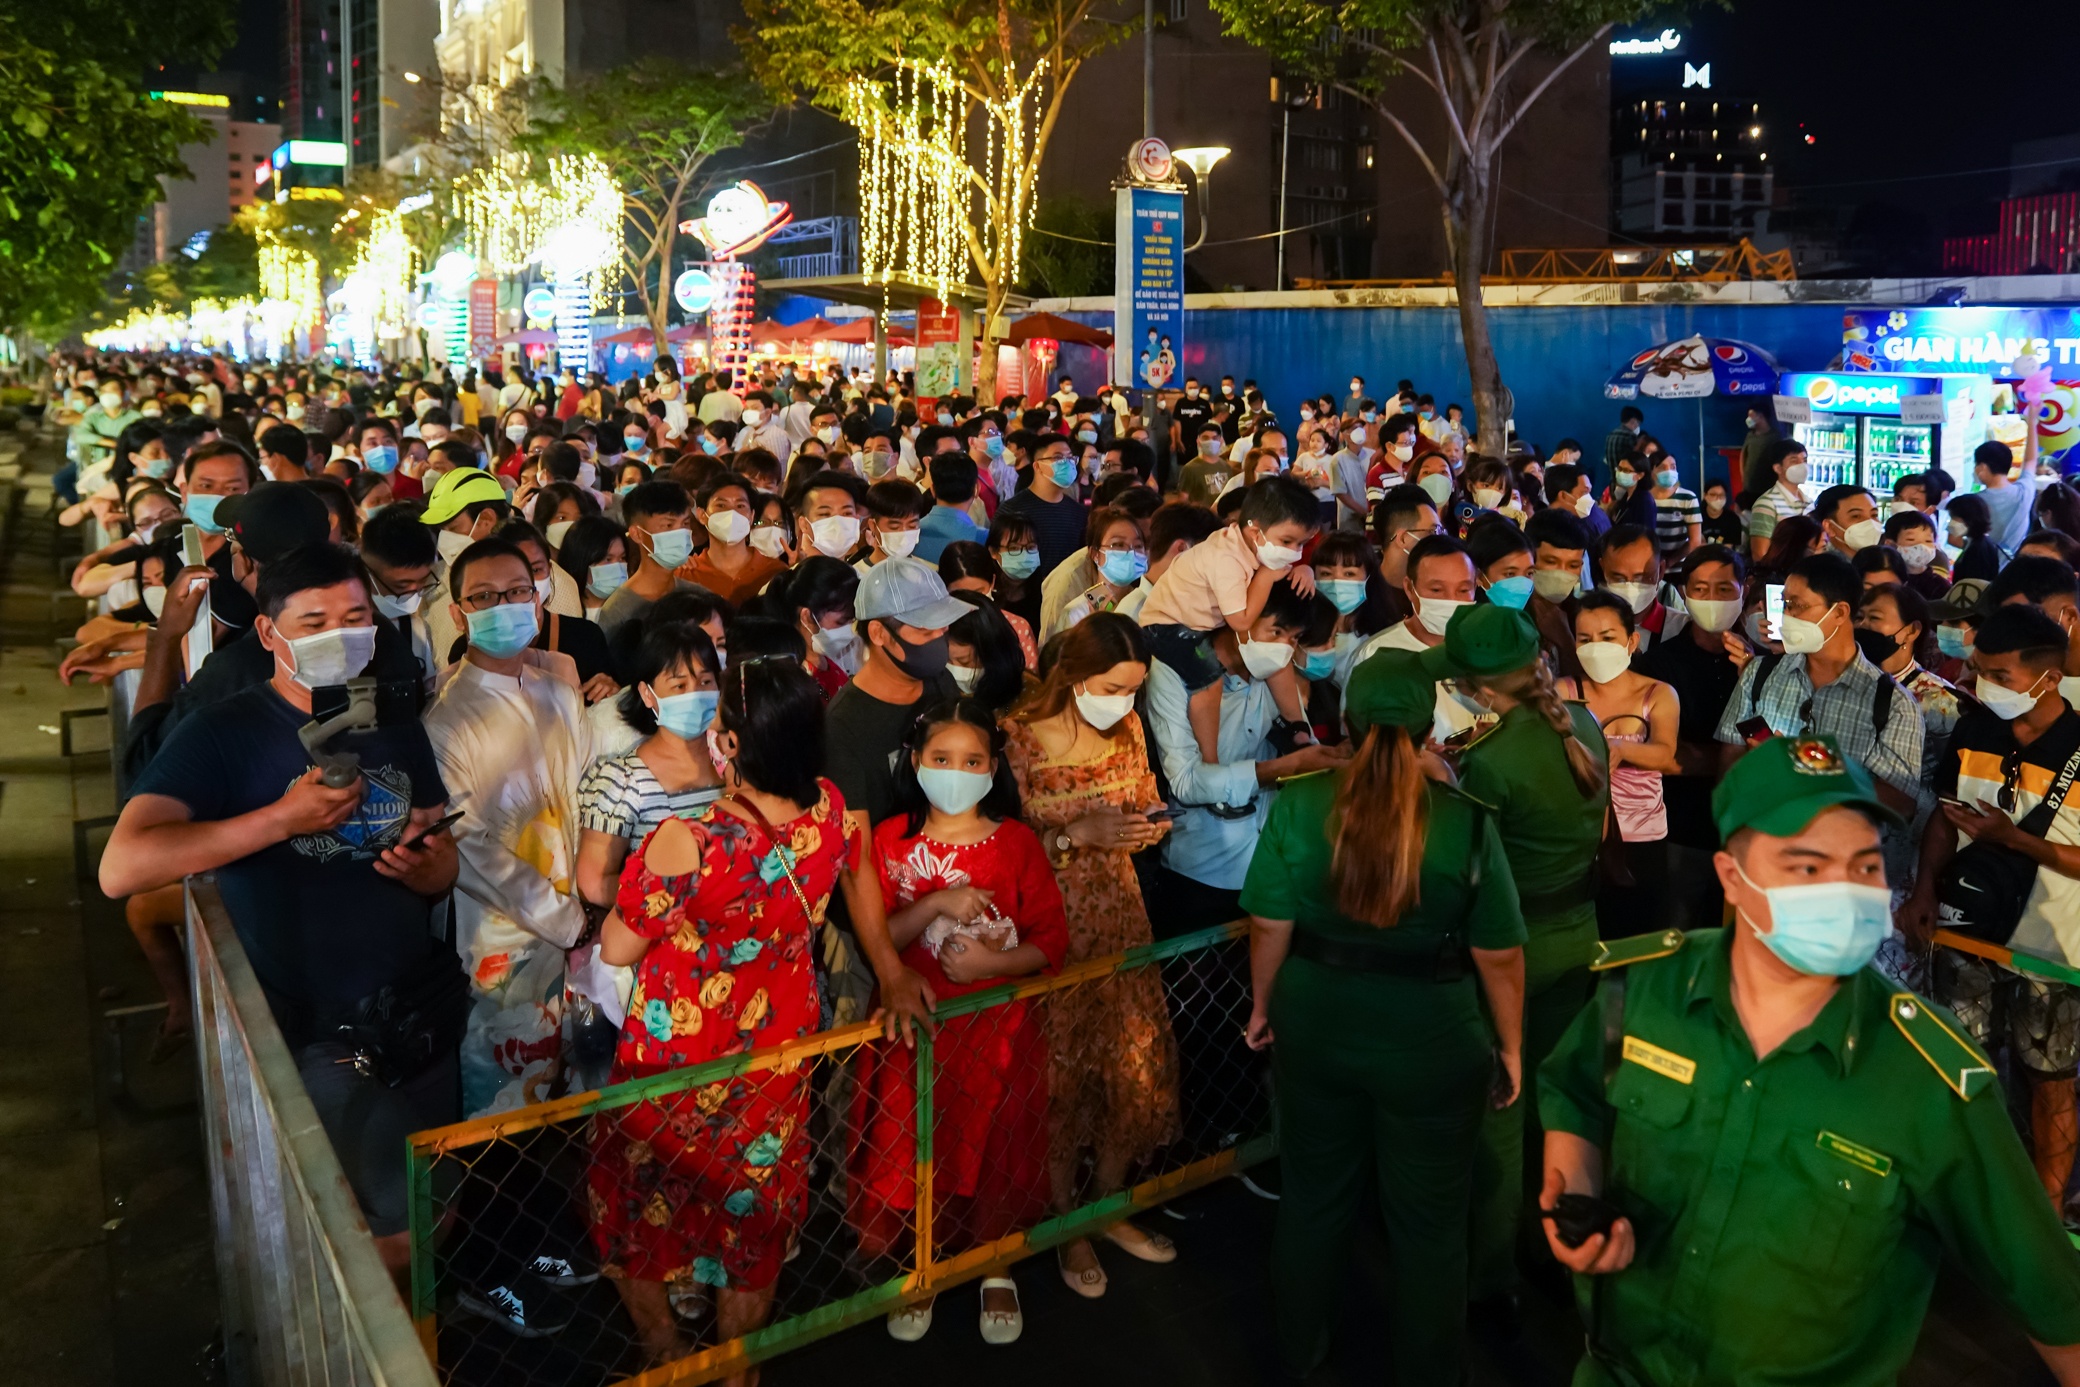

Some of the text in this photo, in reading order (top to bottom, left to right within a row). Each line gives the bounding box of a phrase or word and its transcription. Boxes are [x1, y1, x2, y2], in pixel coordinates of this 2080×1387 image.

[1883, 336, 1956, 362] GIAN
[1960, 331, 2050, 364] HÀNG
[1151, 367, 1161, 378] 5K
[1741, 382, 1766, 392] pepsi
[1838, 384, 1901, 408] pepsi
